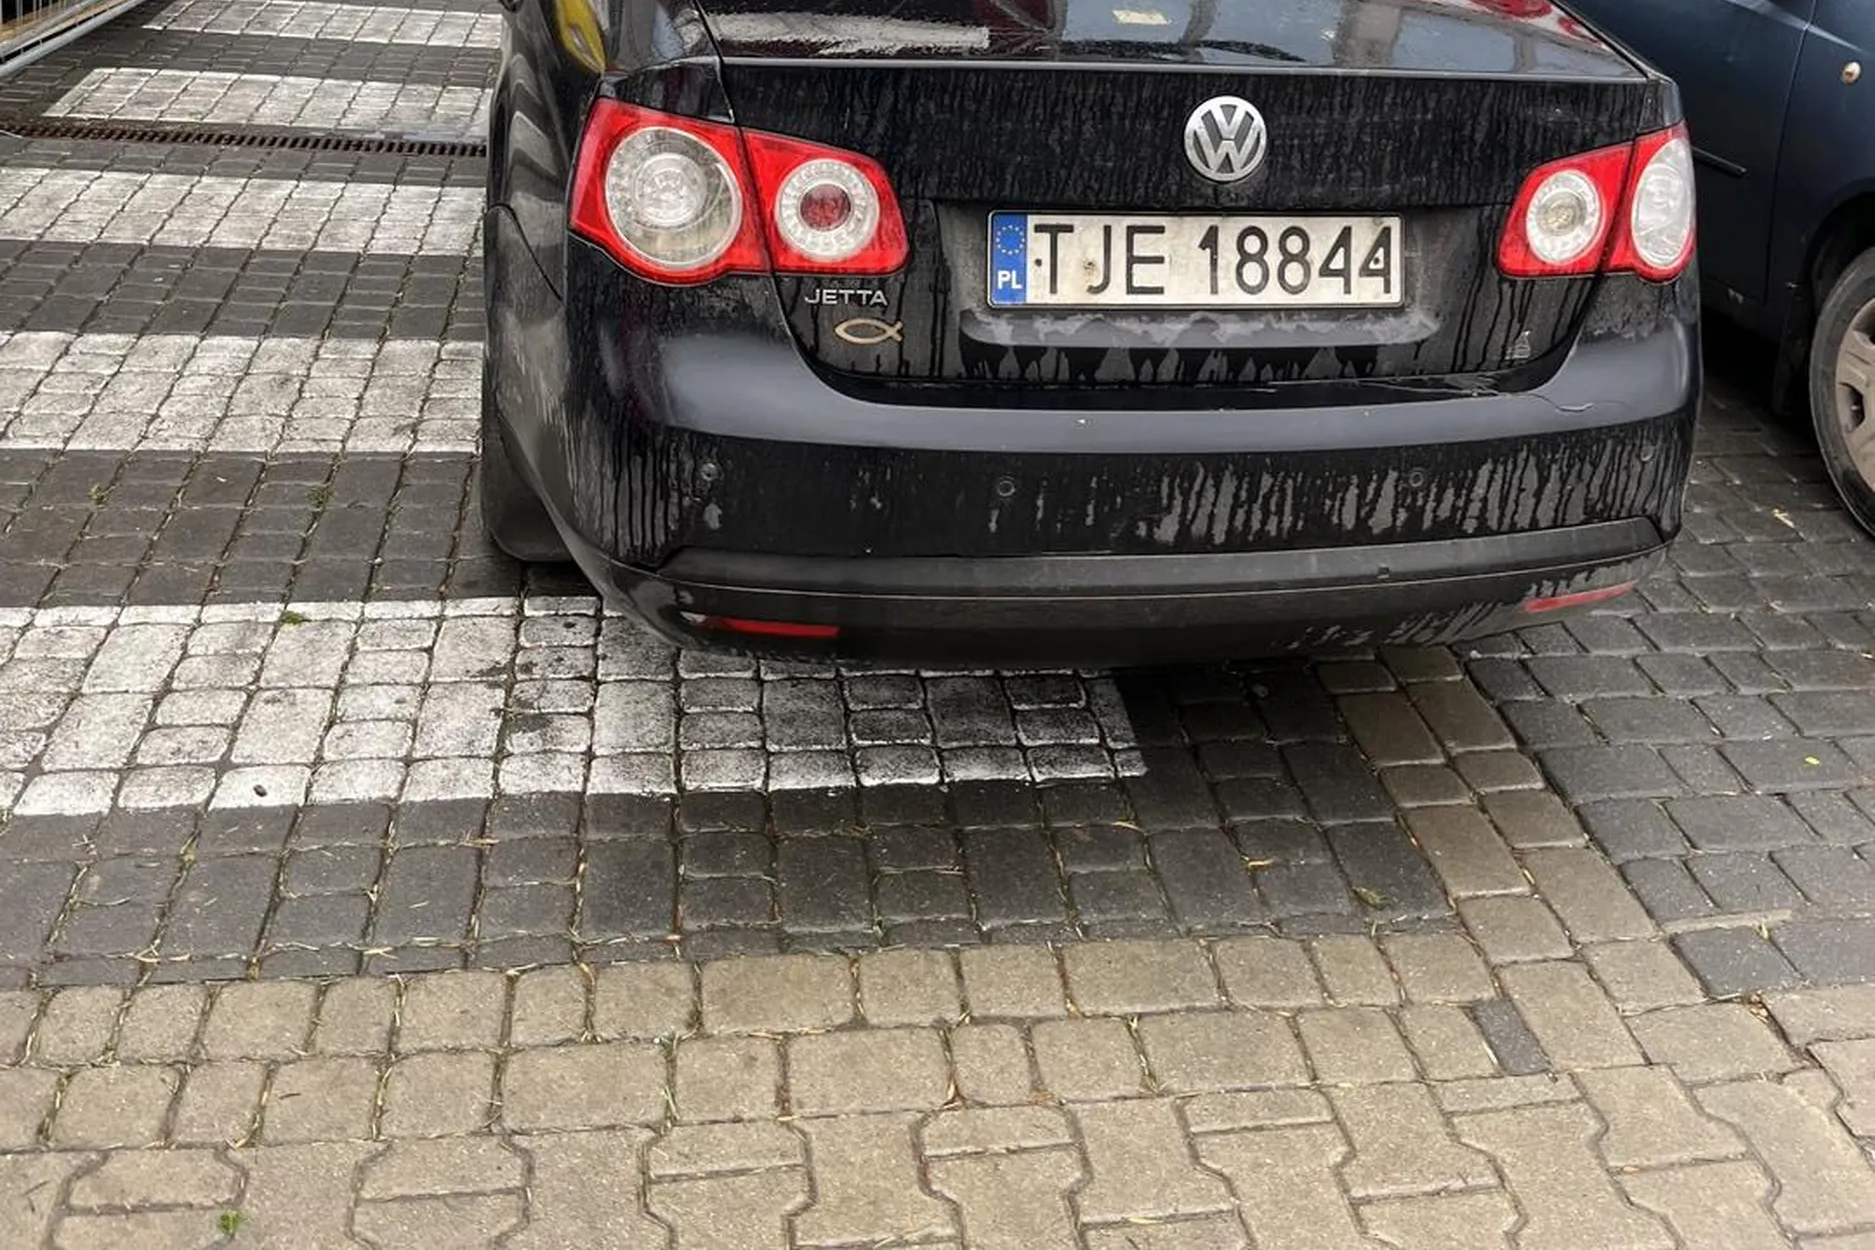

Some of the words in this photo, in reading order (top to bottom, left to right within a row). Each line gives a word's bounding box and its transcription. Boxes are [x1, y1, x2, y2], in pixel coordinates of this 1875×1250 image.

[1198, 224, 1392, 295] 18844
[997, 270, 1022, 290] PL
[804, 288, 888, 307] JETTA
